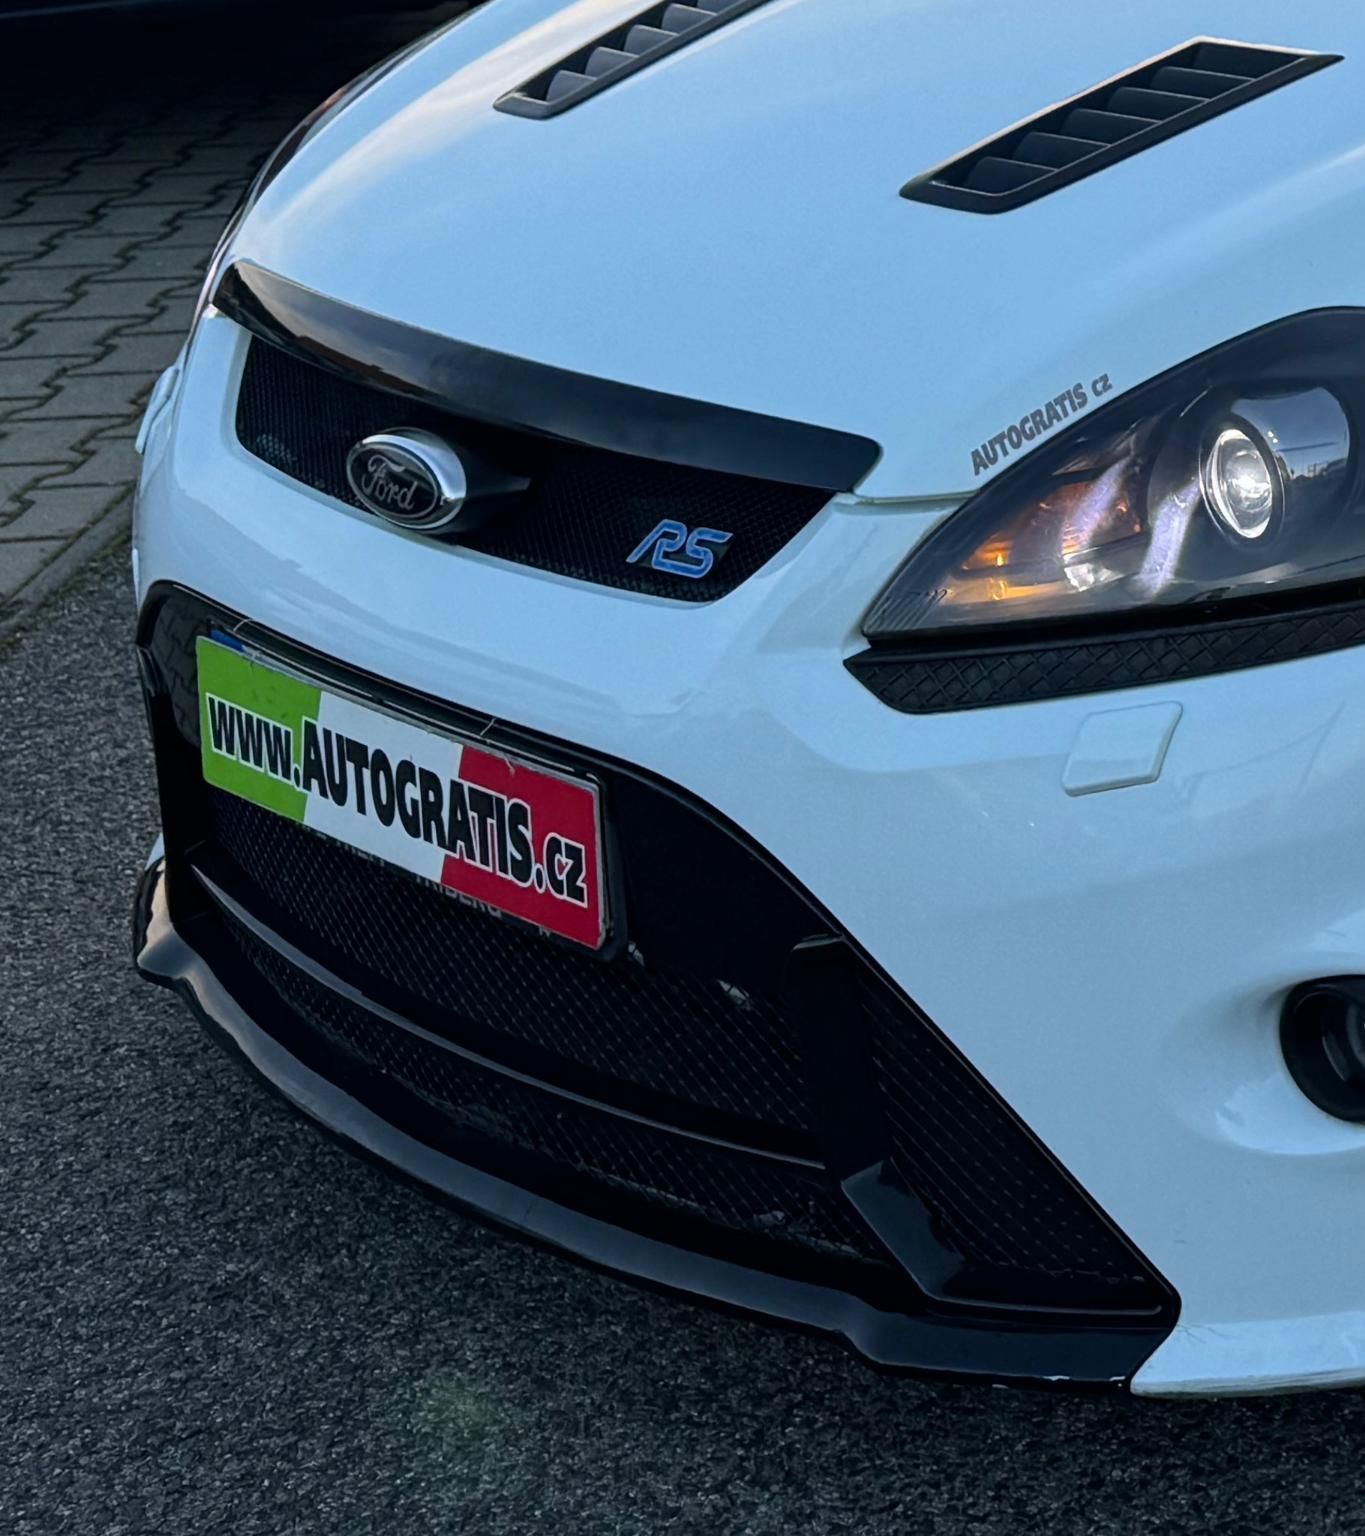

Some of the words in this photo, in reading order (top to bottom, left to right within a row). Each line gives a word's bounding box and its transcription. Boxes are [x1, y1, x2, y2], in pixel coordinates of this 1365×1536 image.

[360, 454, 418, 511] Ford
[625, 518, 734, 579] RS
[206, 694, 588, 908] www.AUTOGRATIS.cz
